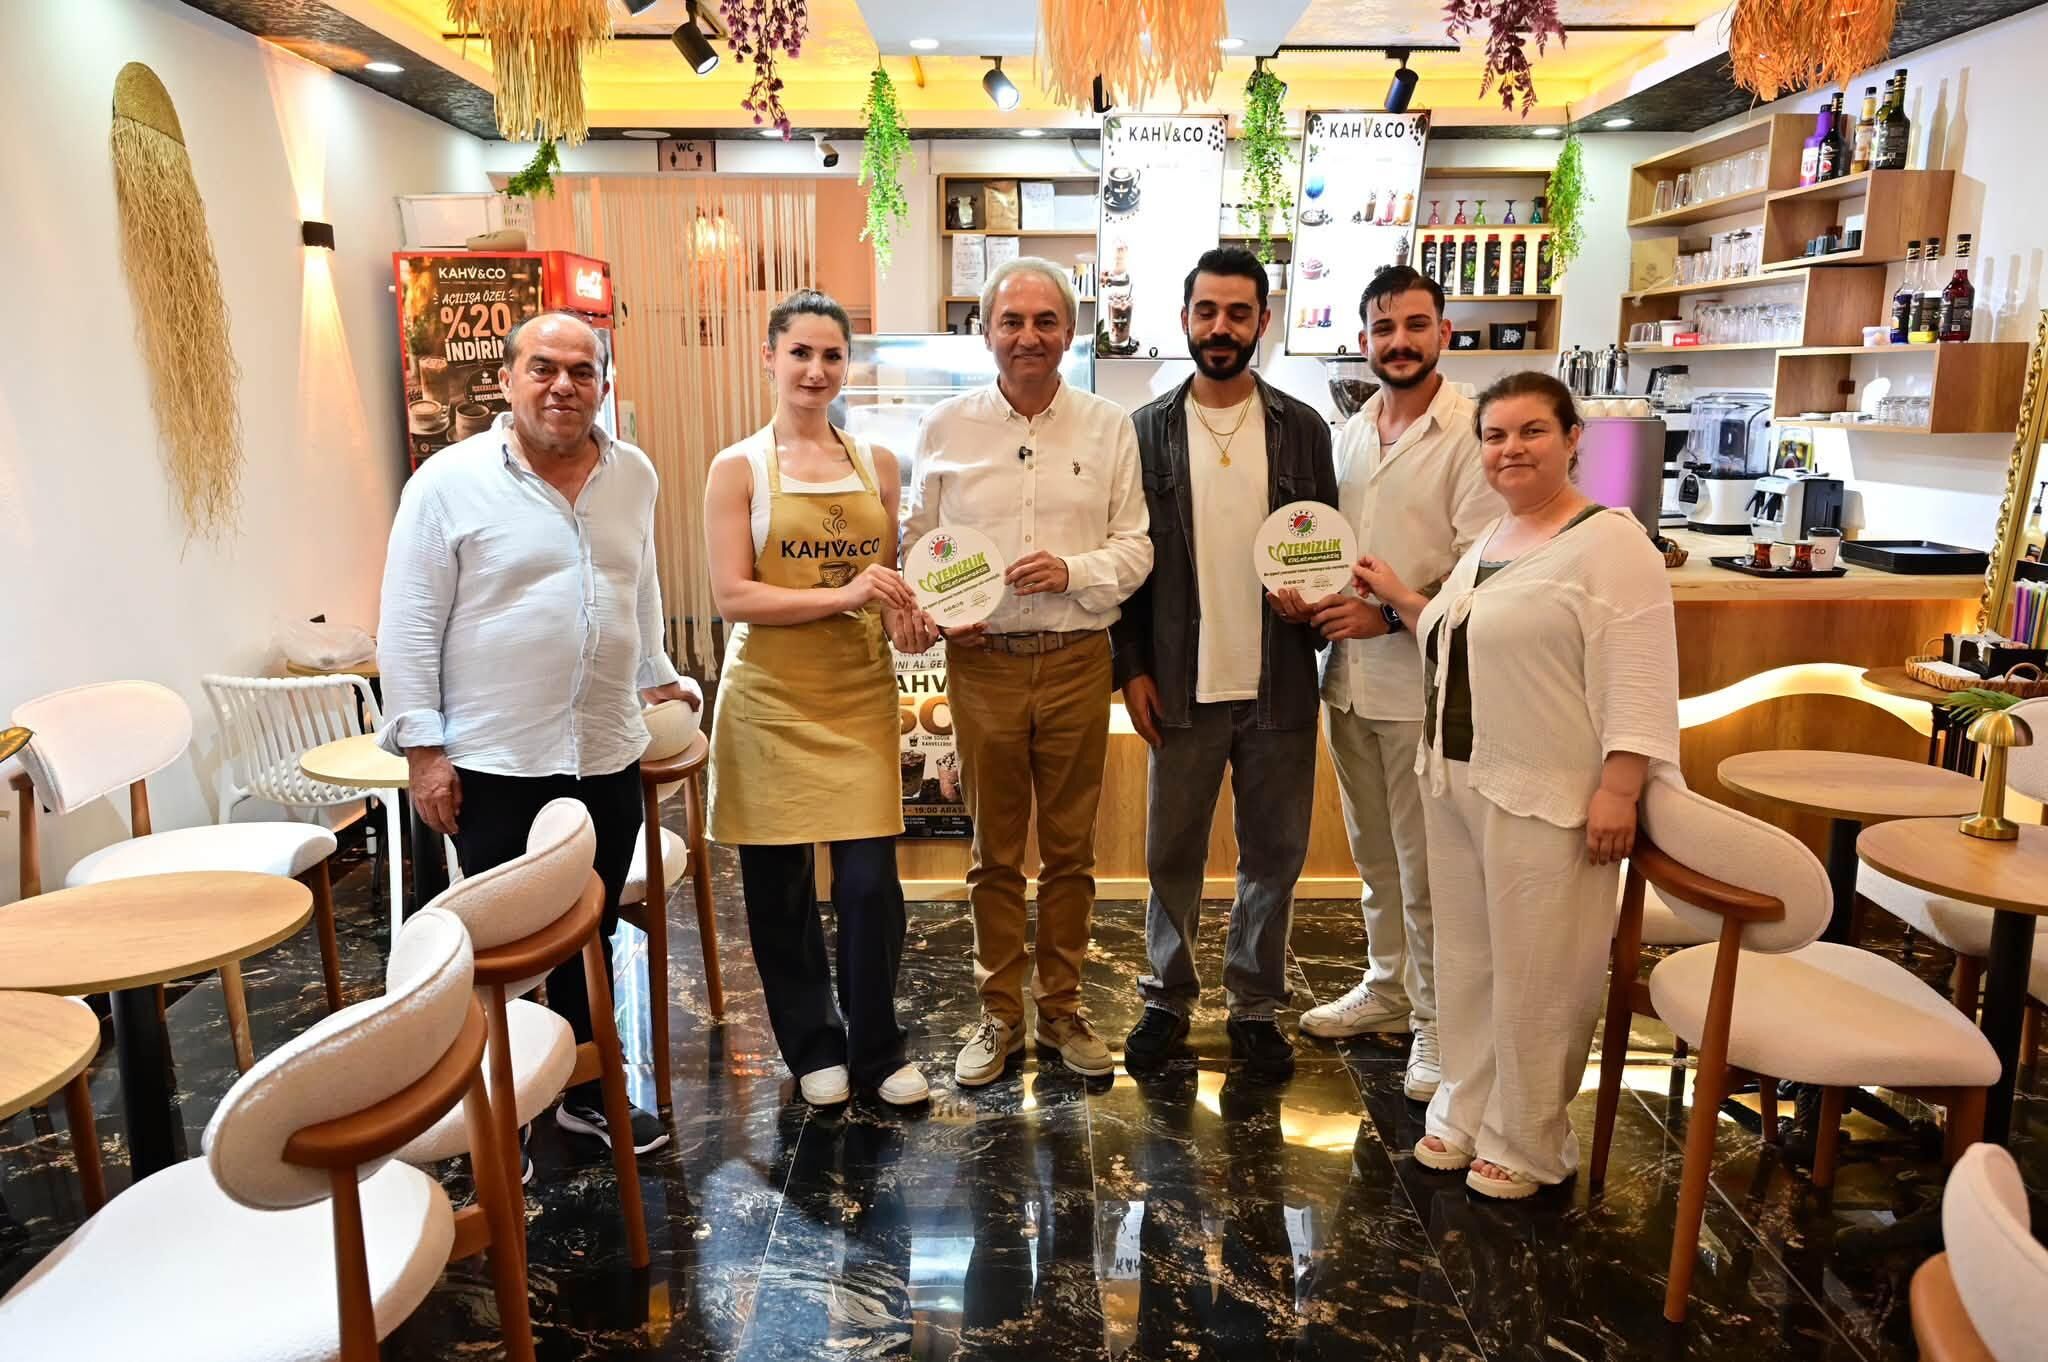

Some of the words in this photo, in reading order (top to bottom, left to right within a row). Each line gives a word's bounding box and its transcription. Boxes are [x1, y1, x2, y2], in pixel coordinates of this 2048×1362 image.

[1129, 122, 1204, 142] KAHV&CO
[1329, 118, 1405, 138] KAHV&CO
[676, 142, 695, 152] WC
[438, 266, 506, 280] KAHV&CO
[442, 292, 481, 305] AÇILIŞA
[483, 289, 507, 302] ÖZEL
[440, 303, 512, 339] %20
[781, 537, 880, 558] KAHV&CO
[913, 660, 926, 669] AL
